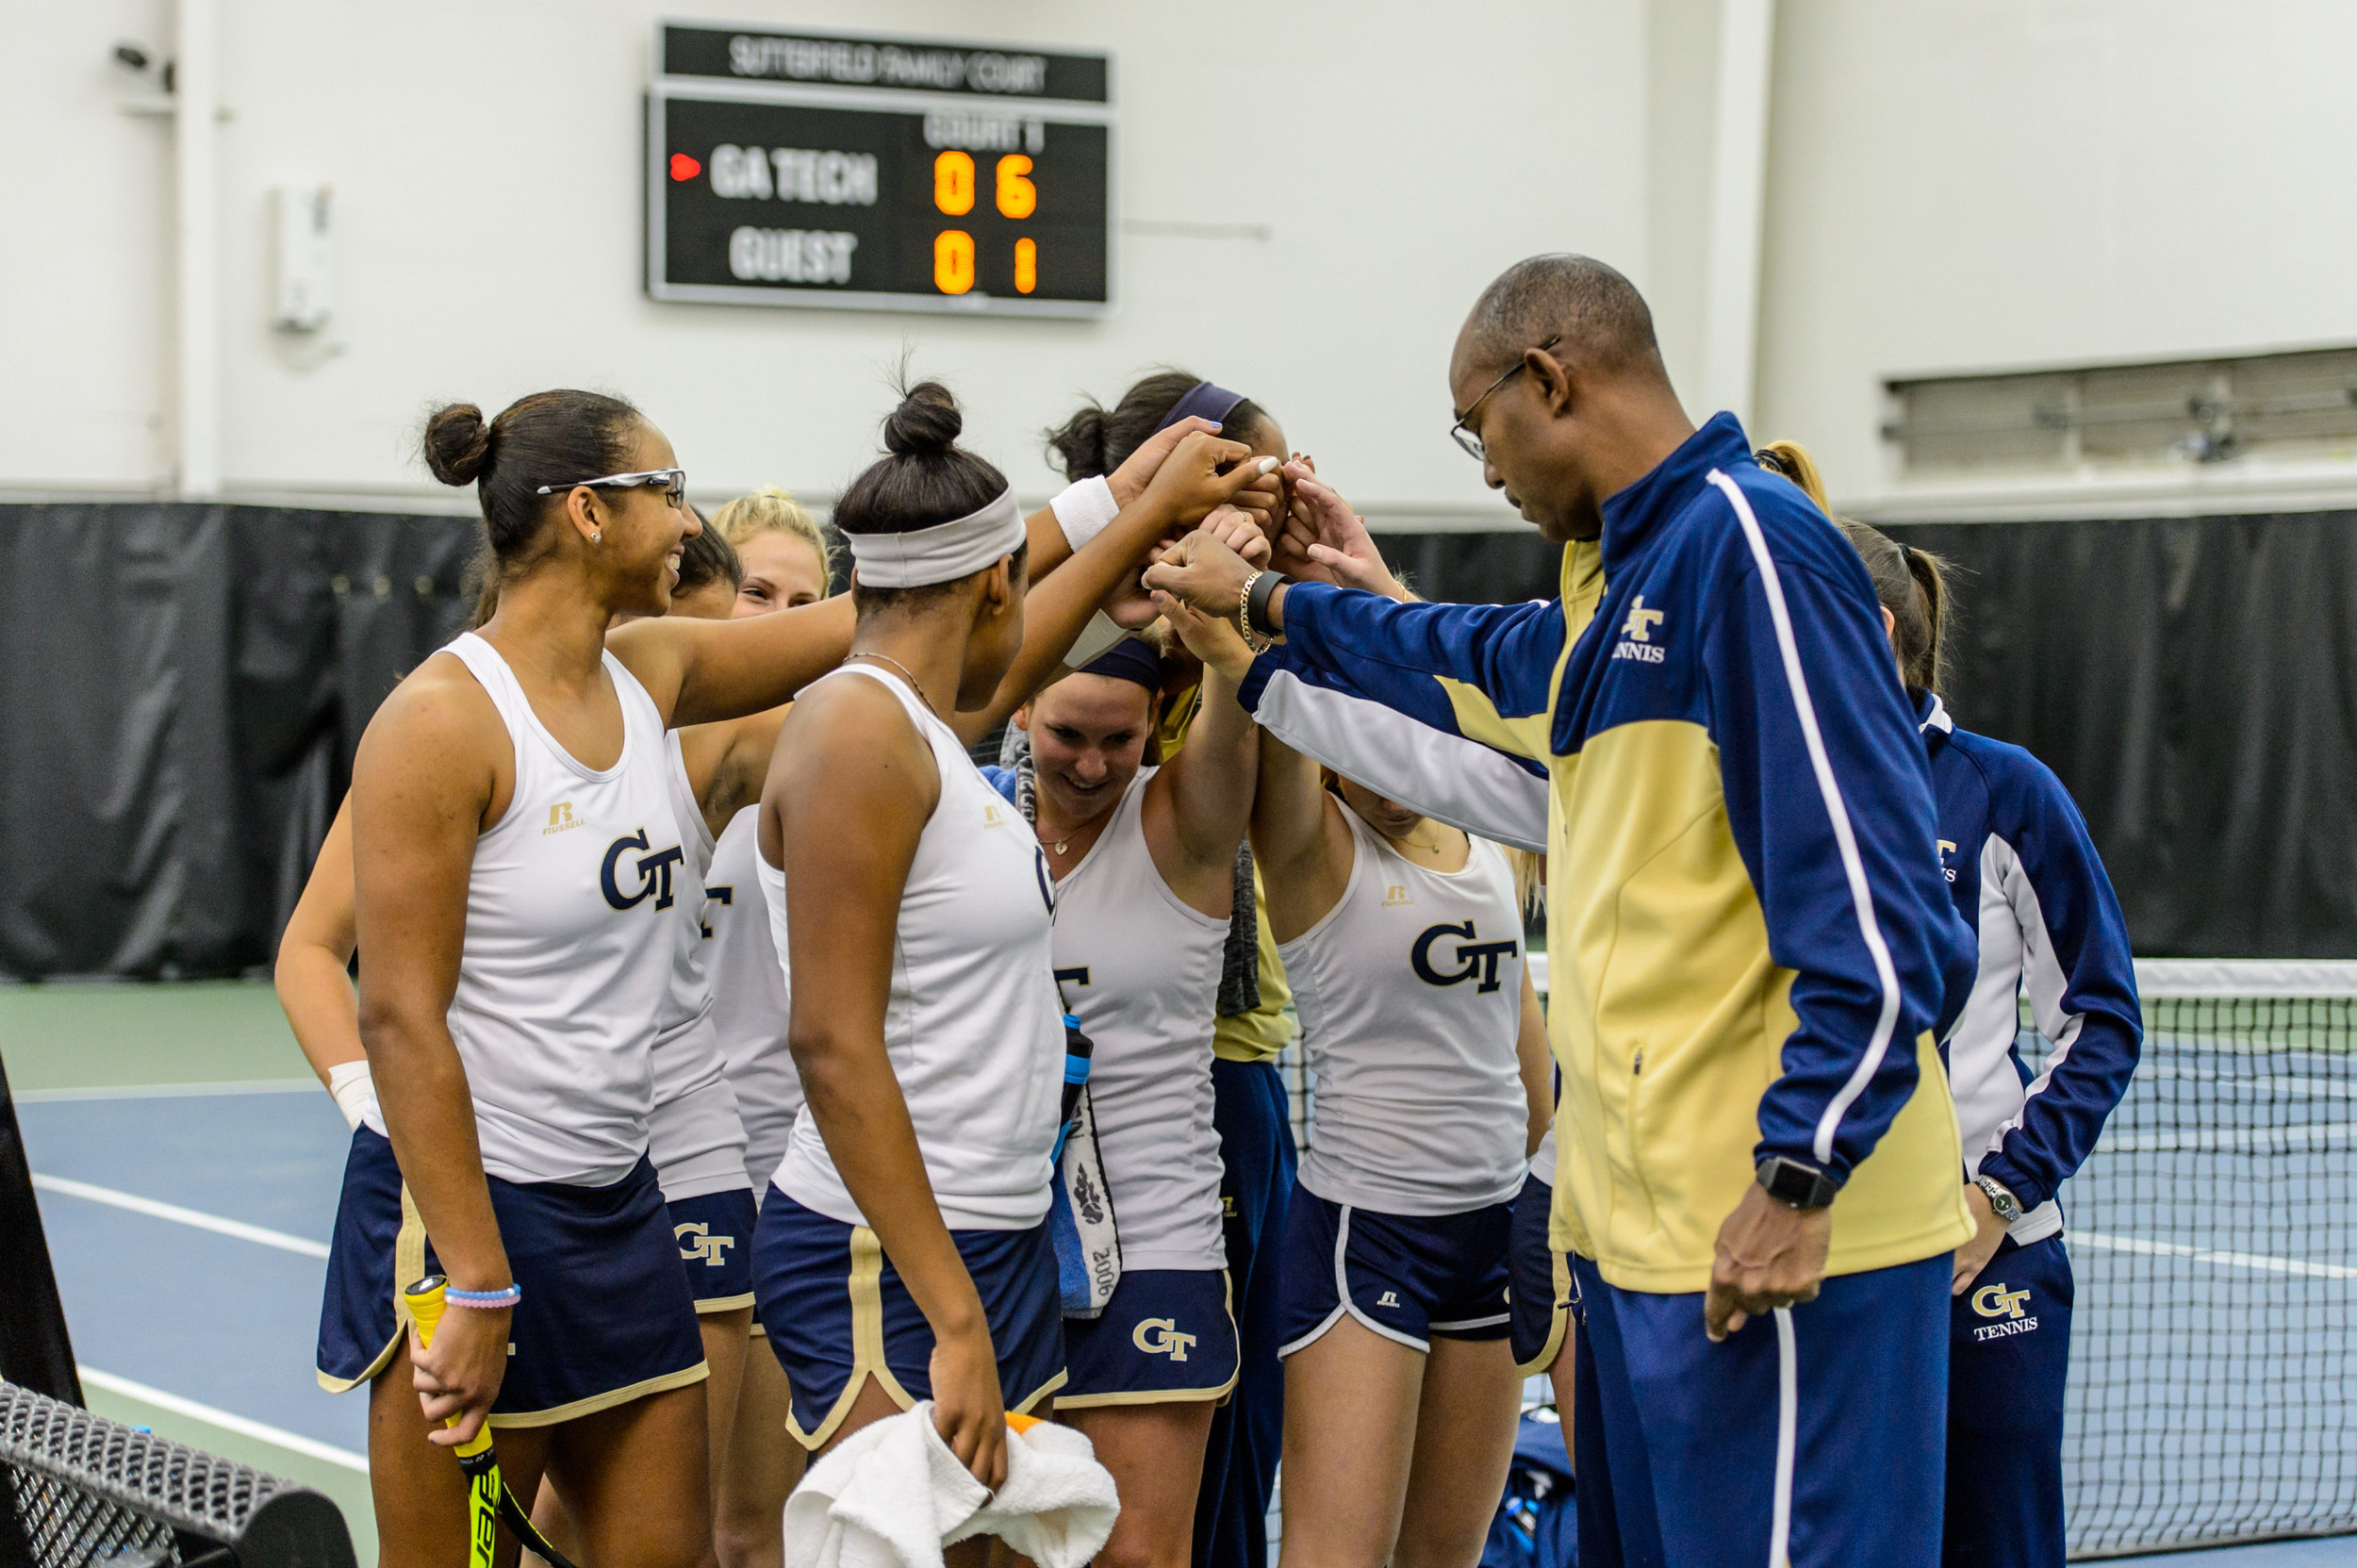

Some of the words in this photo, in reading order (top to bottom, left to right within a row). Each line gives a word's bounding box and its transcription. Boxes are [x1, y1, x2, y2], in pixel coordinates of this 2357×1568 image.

[878, 45, 964, 90] FAMILY
[966, 51, 1047, 93] COURT
[710, 143, 772, 199] GA
[770, 147, 878, 206] TECH
[934, 151, 975, 216] 0
[996, 155, 1036, 220] 6
[729, 225, 857, 285] GUEST
[934, 229, 975, 295] 0
[1014, 237, 1036, 294] 1
[1621, 595, 1664, 642] T
[542, 817, 586, 835] RUSSELL
[598, 825, 685, 914] GT
[1410, 918, 1518, 996] GT
[674, 1222, 734, 1266] GT
[1093, 1247, 1114, 1297] 2006
[1971, 1283, 2031, 1319] GT
[1132, 1317, 1196, 1362] GT
[1973, 1316, 2038, 1341] TENNIS
